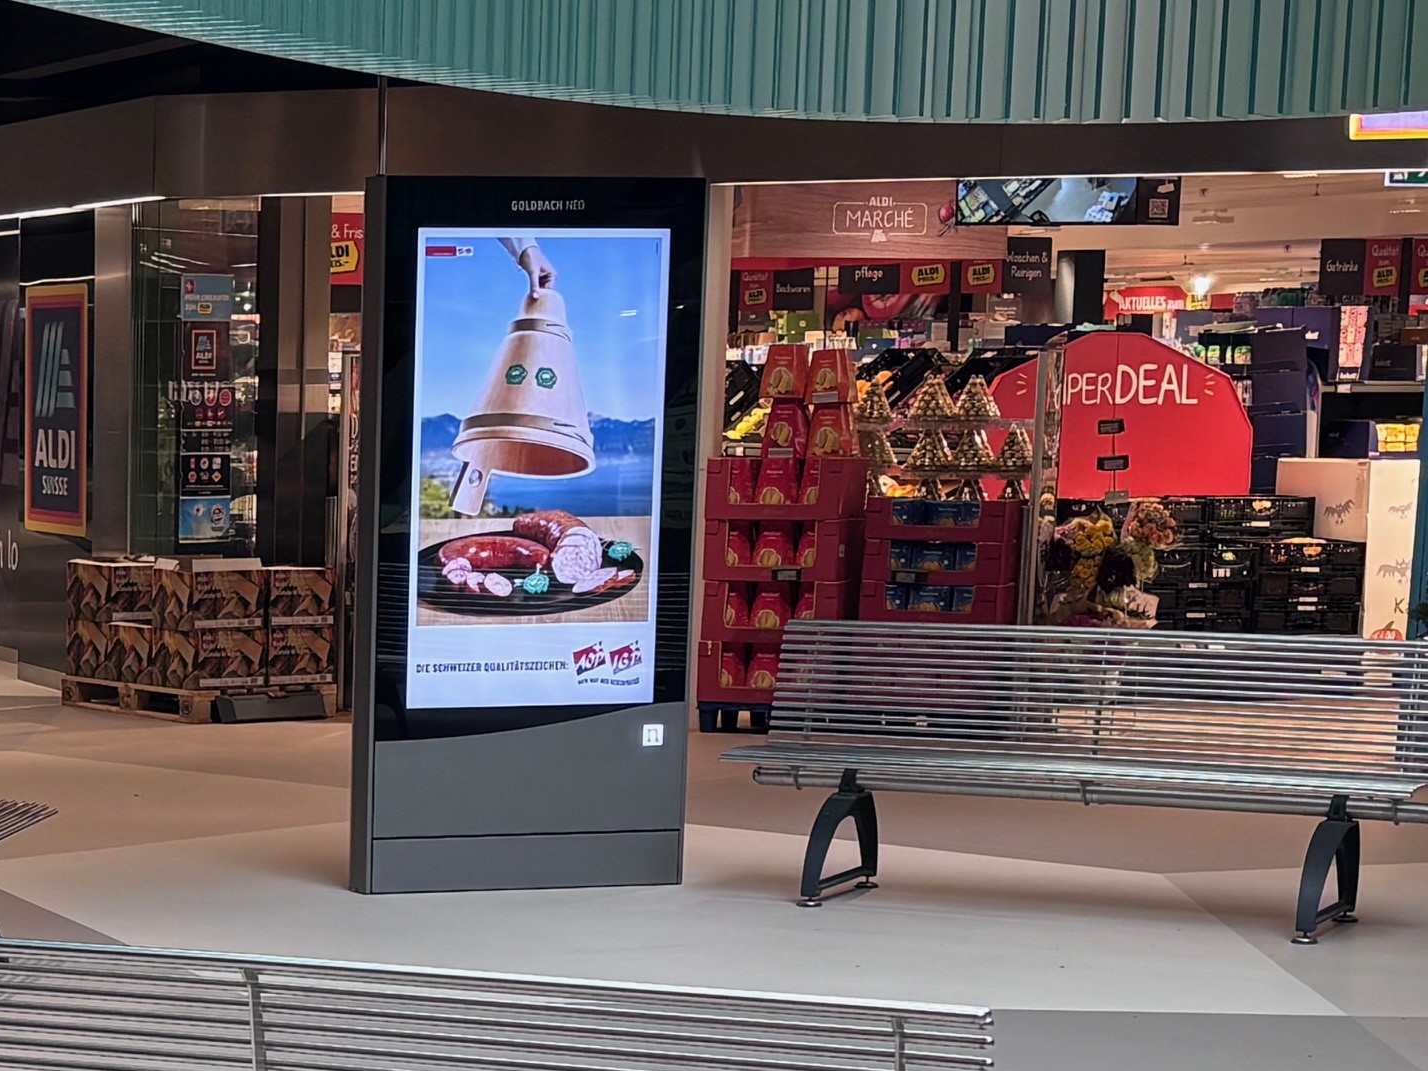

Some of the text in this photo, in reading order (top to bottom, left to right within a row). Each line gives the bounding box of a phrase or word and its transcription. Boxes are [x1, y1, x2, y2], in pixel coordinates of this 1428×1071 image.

[511, 200, 563, 211] GOLDBACH
[868, 196, 893, 208] ALDI
[845, 207, 915, 229] MARCHÉ
[855, 267, 884, 282] pflege
[918, 266, 939, 277] ALDI
[1010, 266, 1043, 281] Reinigen
[1118, 296, 1167, 311] AKTUELLES
[35, 428, 76, 470] ALDI
[42, 475, 68, 496] SUISSE
[432, 662, 482, 673] SCHWEIZER
